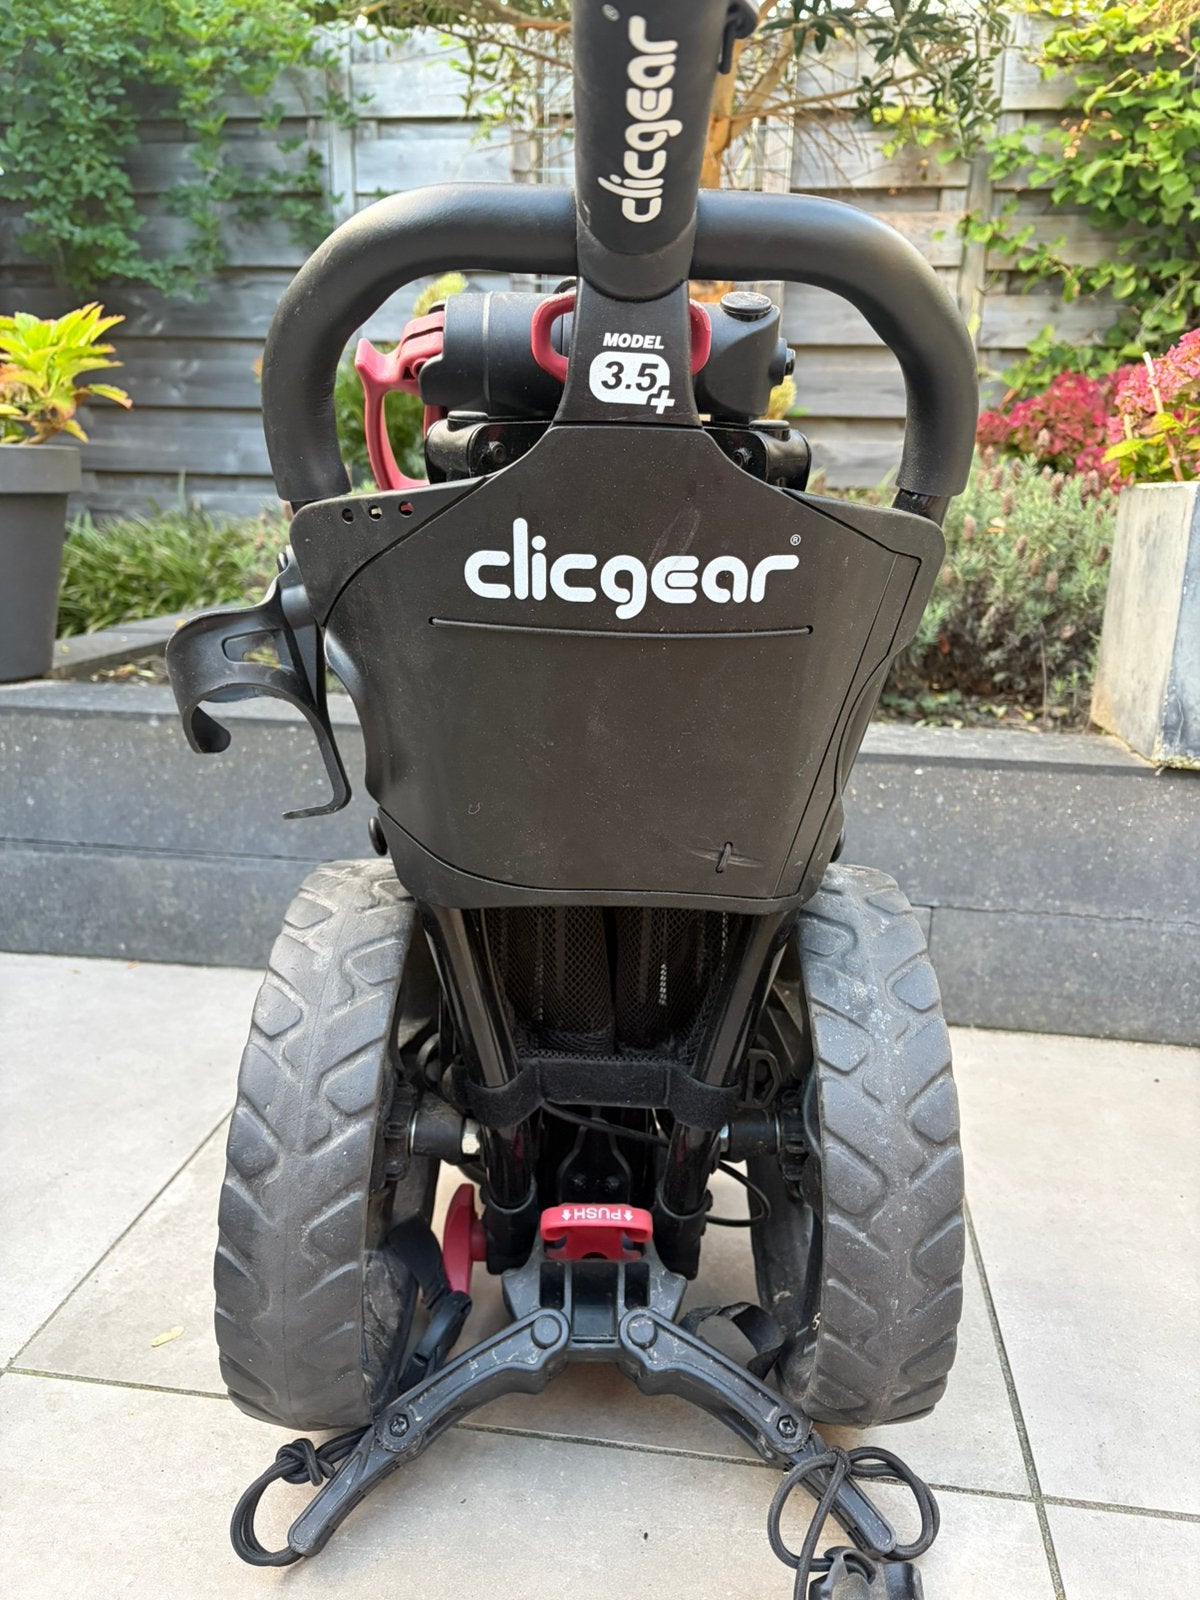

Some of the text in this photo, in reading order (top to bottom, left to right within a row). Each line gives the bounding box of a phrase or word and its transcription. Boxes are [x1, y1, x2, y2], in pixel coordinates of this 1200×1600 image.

[598, 15, 683, 223] clicgear
[602, 332, 665, 350] MODEL
[464, 517, 800, 620] clicgear
[573, 1207, 621, 1220] PUSH
